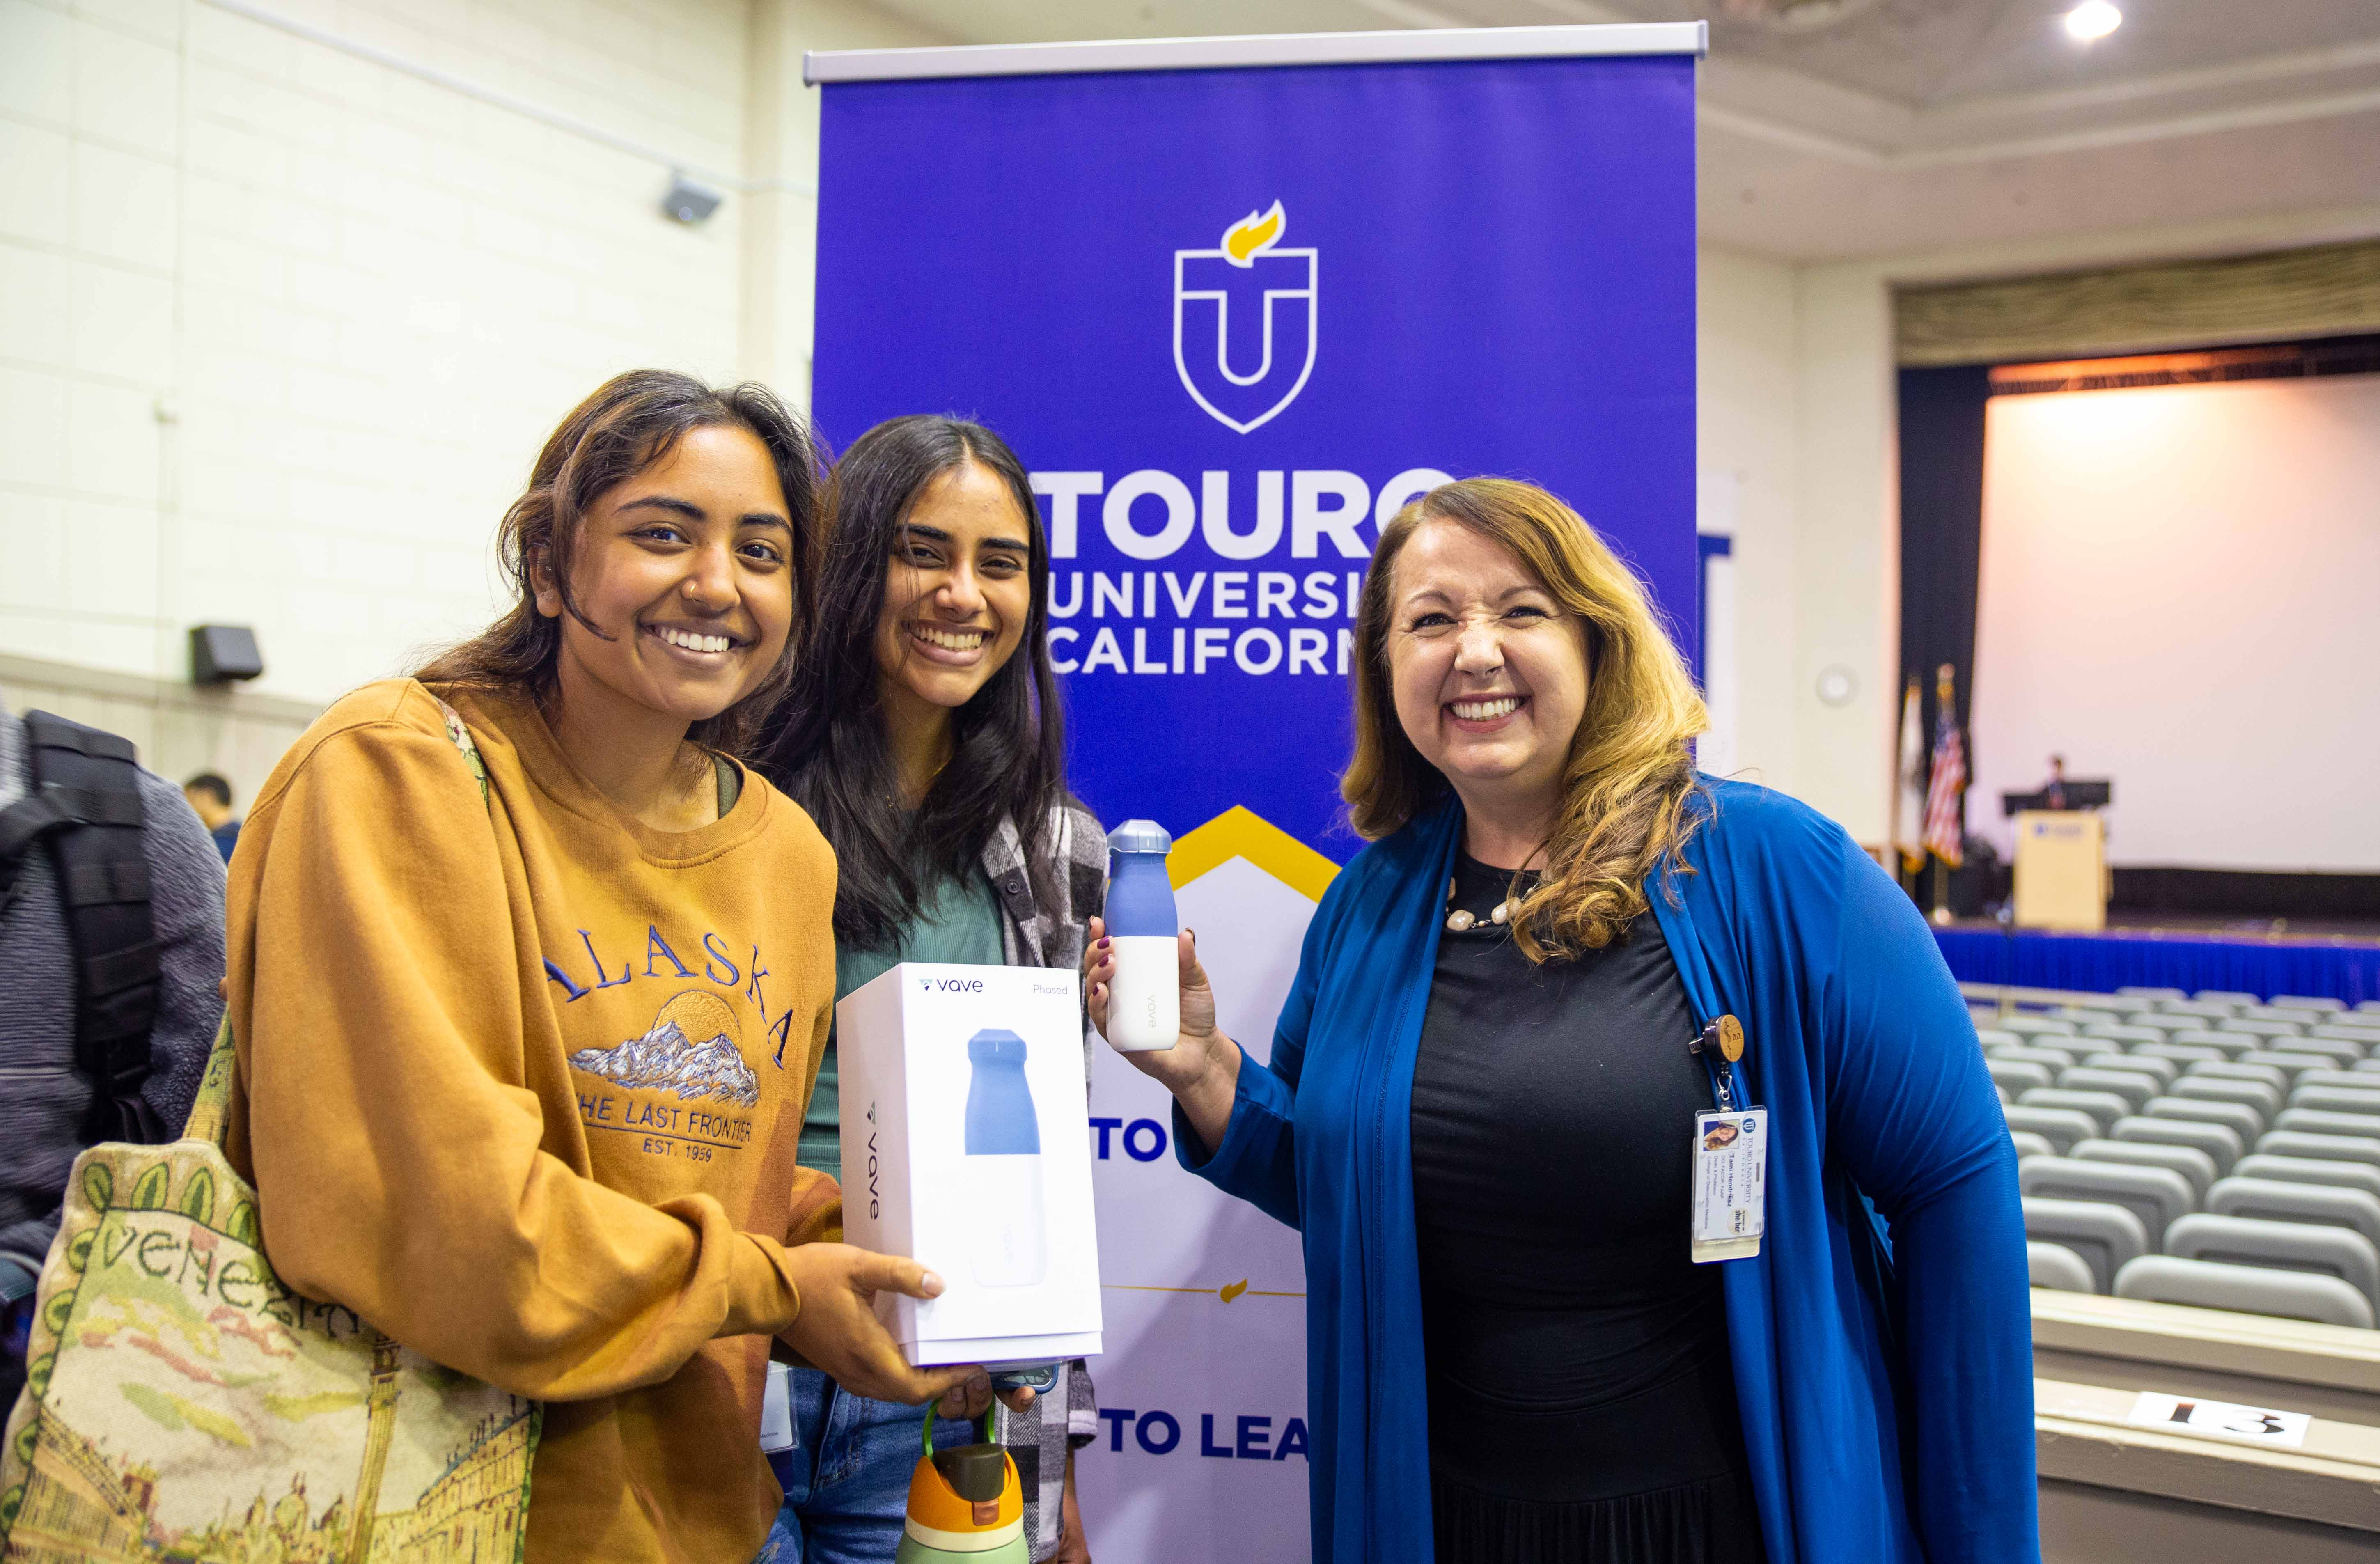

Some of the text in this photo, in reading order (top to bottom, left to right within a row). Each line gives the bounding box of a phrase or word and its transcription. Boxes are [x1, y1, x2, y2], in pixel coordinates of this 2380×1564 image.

[937, 979, 1068, 995] vave Phased
[1147, 995, 1156, 1028] vave
[576, 1093, 752, 1142] HE LAST FRONTIER
[643, 1137, 712, 1162] EST. 1959
[1089, 1117, 1167, 1162] TO
[867, 1132, 879, 1220] vave
[1745, 1163, 1753, 1204] UNIVERSITY
[1098, 1408, 1181, 1454] TO
[2168, 1402, 2284, 1434] 13
